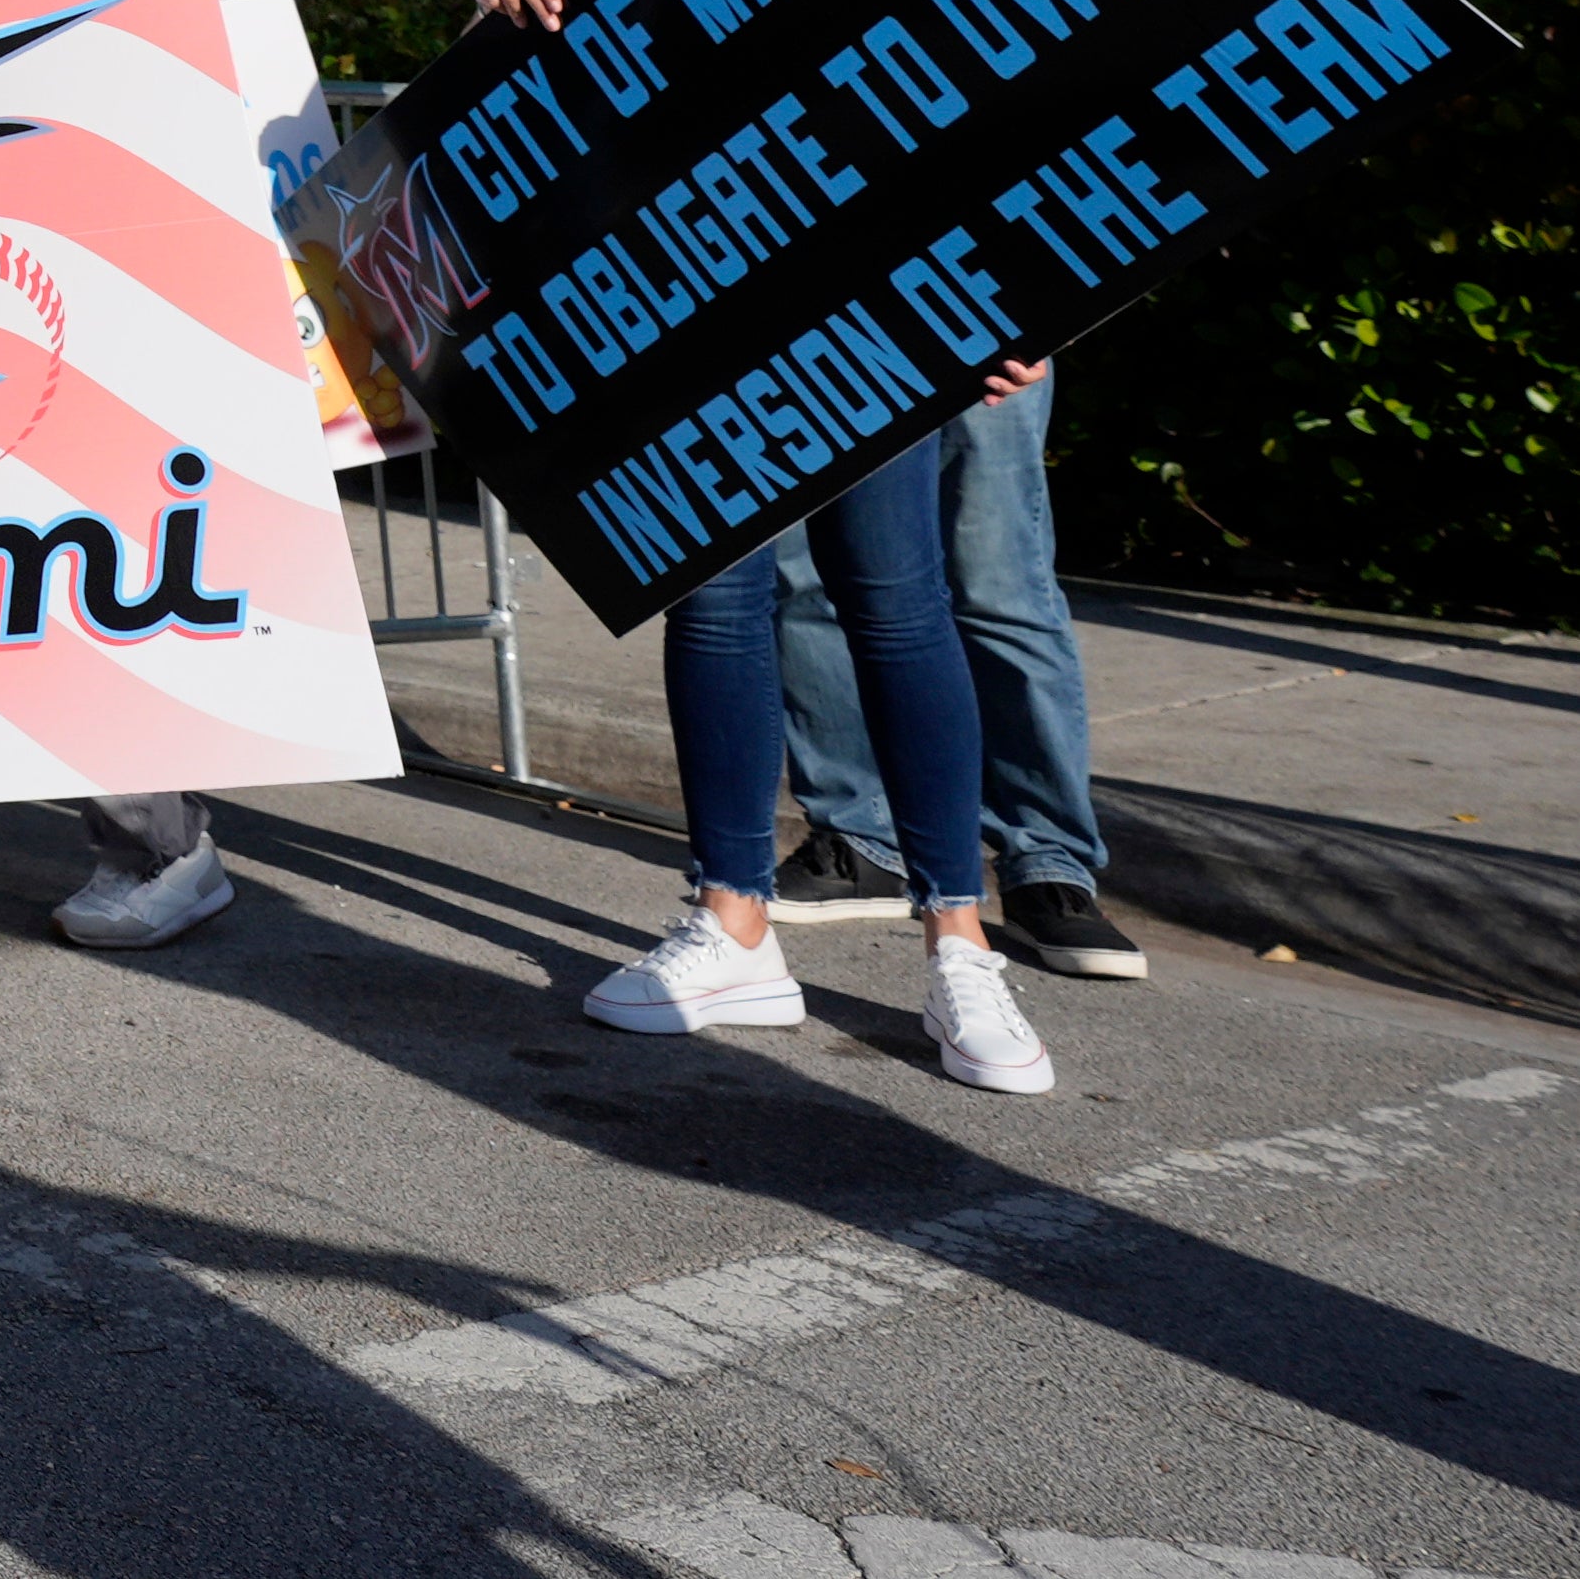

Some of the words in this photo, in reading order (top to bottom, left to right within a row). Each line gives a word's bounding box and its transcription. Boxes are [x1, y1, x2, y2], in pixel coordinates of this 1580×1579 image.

[440, 54, 590, 222] CITY
[461, 311, 576, 434] TO
[540, 92, 868, 377] OBLIGATE
[819, 16, 969, 154] TO
[577, 299, 937, 586] INVERSION
[889, 225, 1023, 367] OF
[991, 115, 1209, 288] THE
